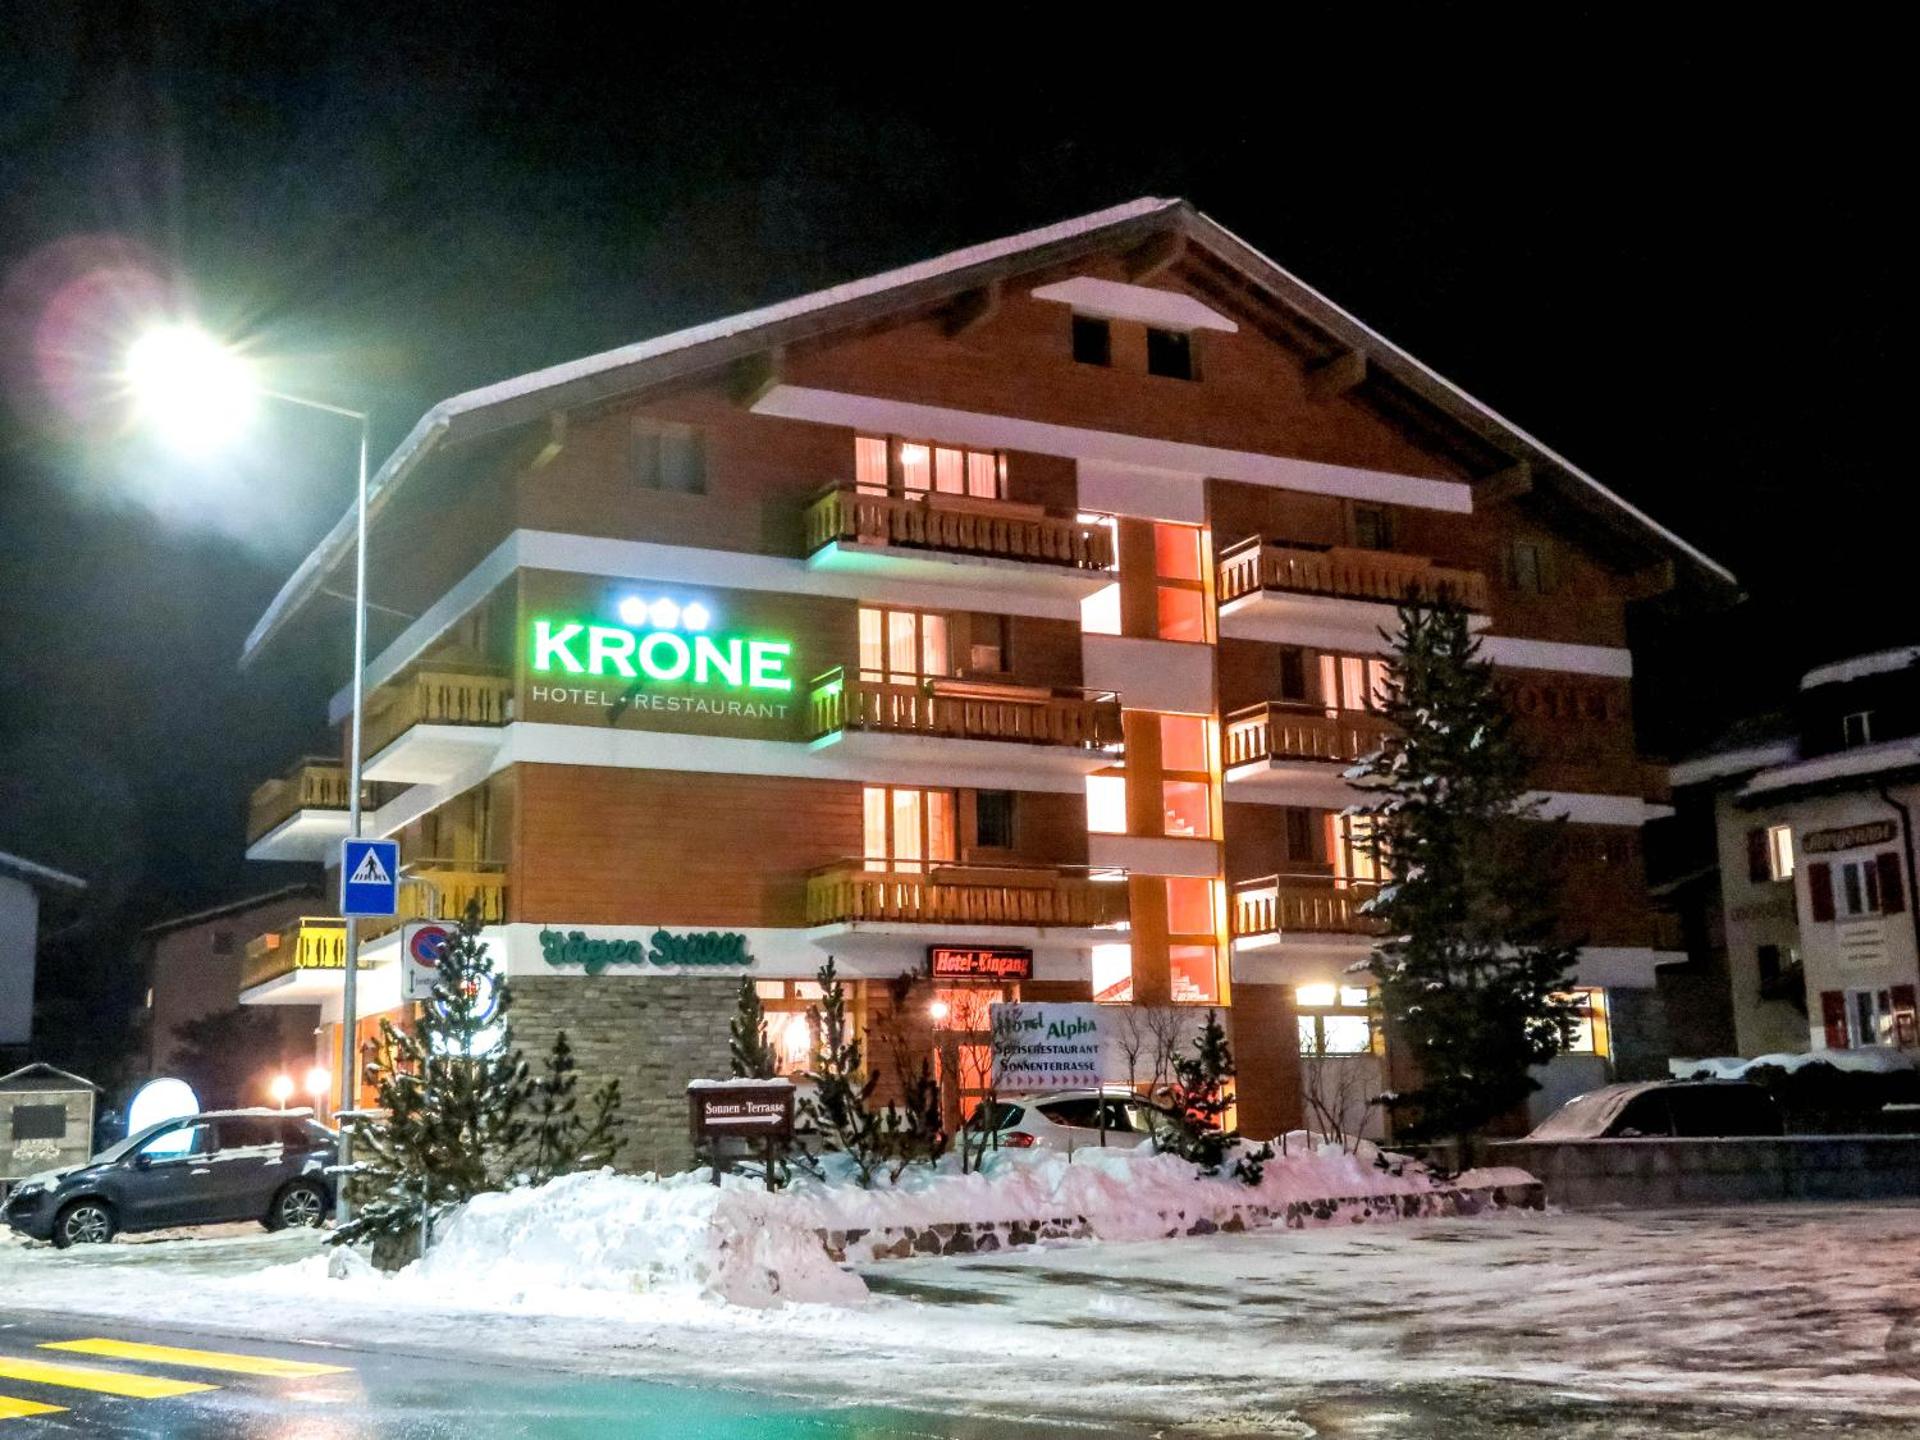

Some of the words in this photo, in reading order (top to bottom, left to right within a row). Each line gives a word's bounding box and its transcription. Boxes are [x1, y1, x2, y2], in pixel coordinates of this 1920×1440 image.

[533, 621, 792, 691] KRONE
[532, 686, 614, 706] HOTEL
[635, 694, 789, 719] RESTAURANT
[1000, 1058, 1096, 1072] SONNENTERRASSE
